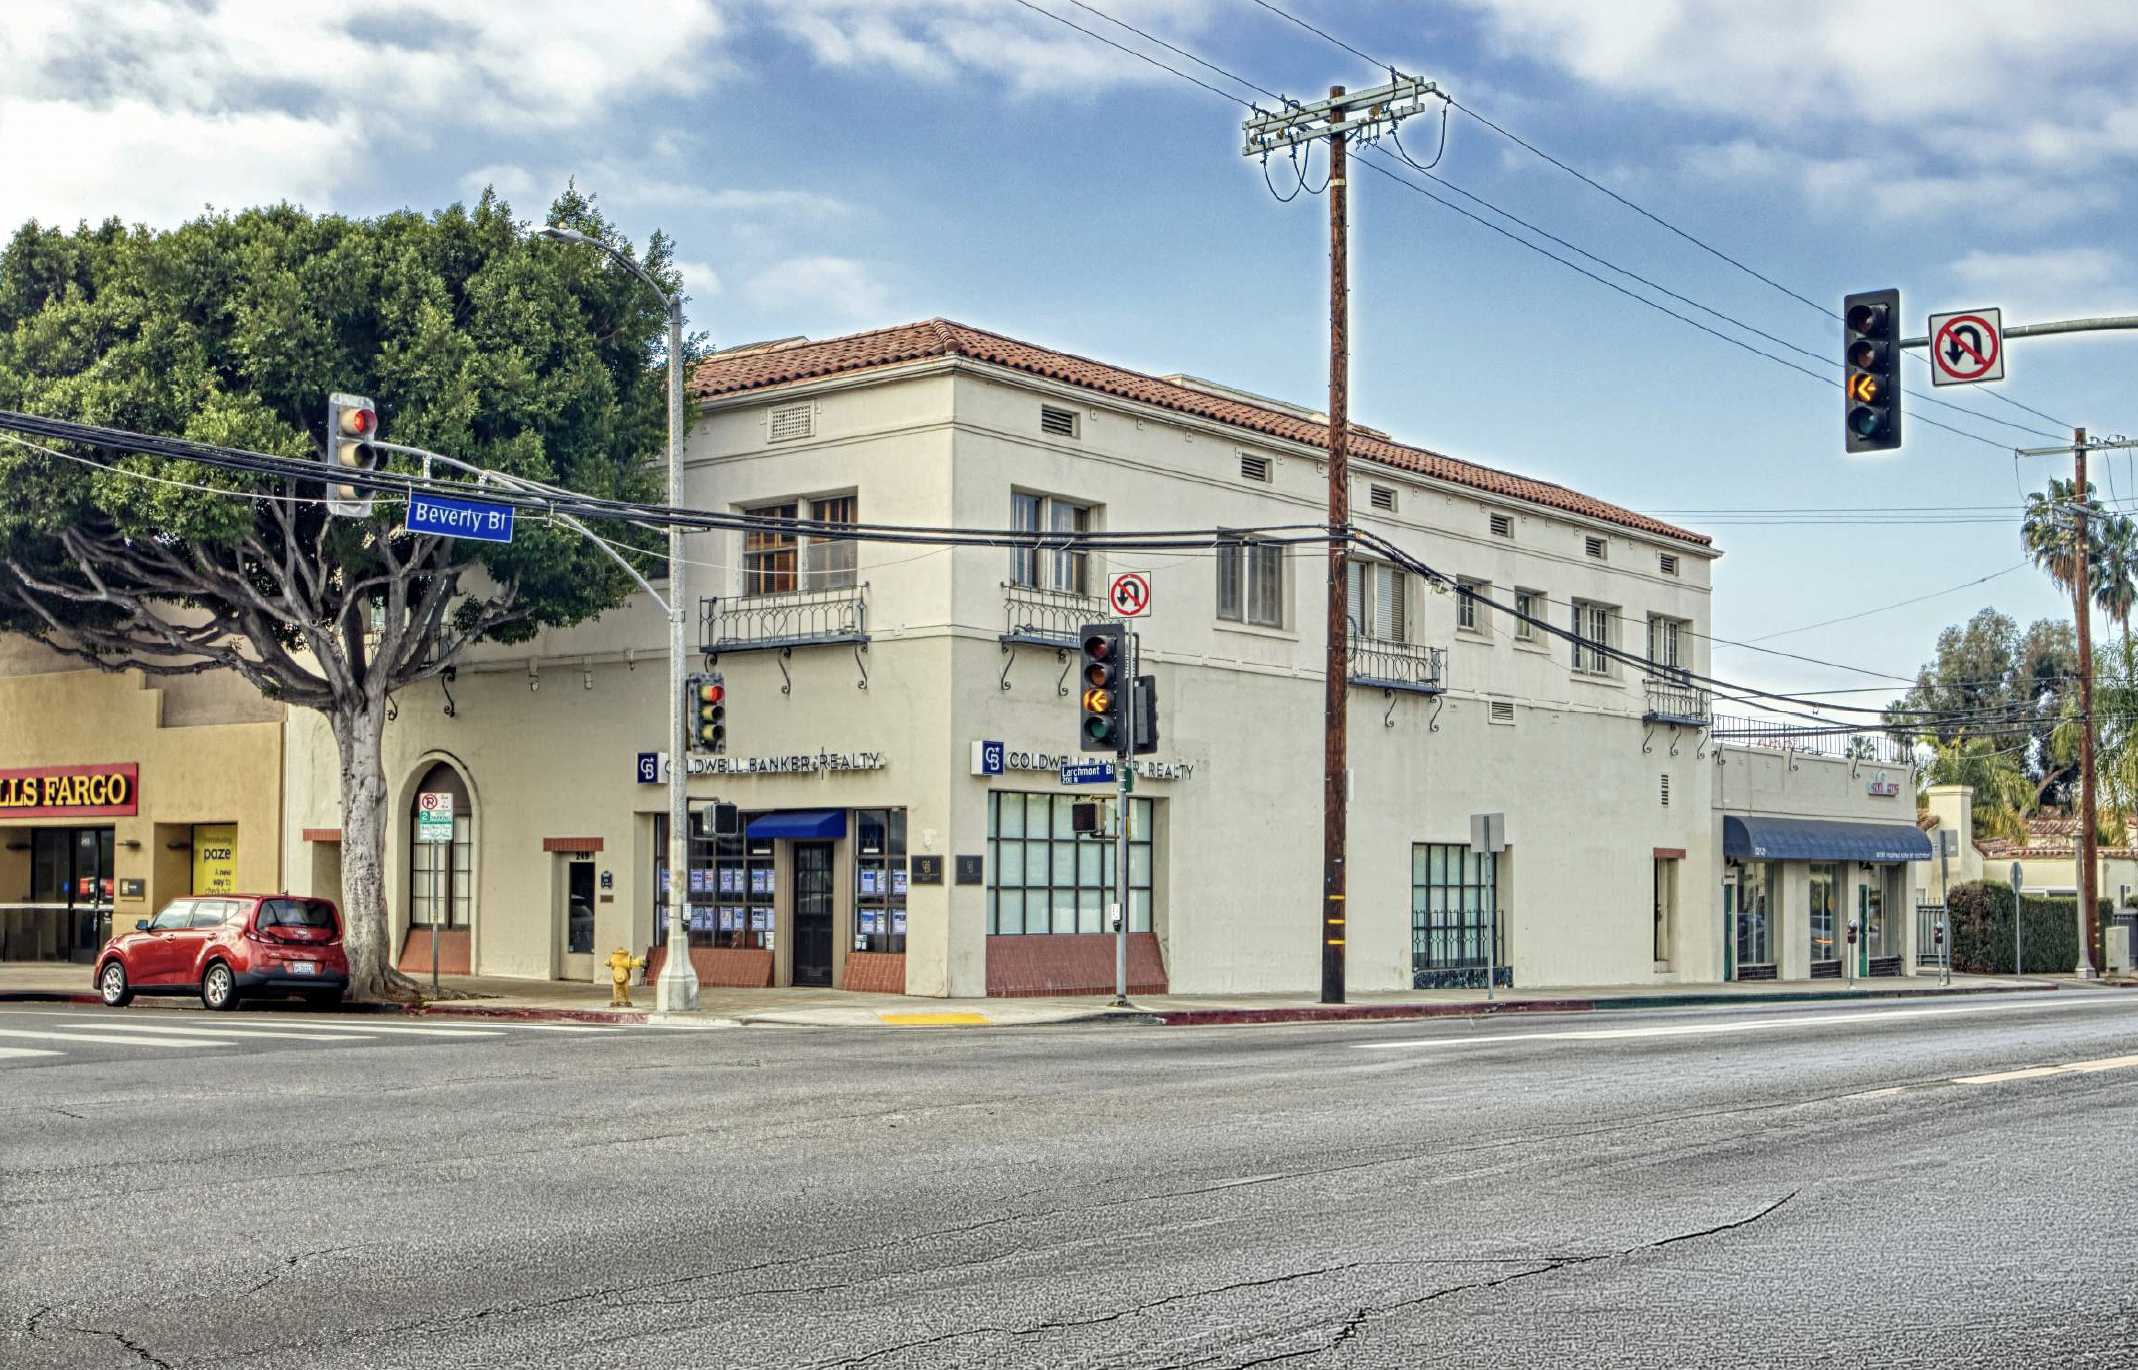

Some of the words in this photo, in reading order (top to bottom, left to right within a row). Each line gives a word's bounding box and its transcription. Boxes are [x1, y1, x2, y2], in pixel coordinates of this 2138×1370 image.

[416, 502, 482, 533] Beverly
[488, 511, 506, 531] Bl
[664, 757, 743, 774] CLDWELL
[749, 756, 810, 772] BANKER
[819, 752, 879, 770] REALTY
[1062, 765, 1100, 777] Larchmont
[1105, 764, 1114, 775] Bl
[1148, 761, 1194, 780] REALTY
[43, 773, 126, 806] FARGO
[204, 848, 231, 863] paze
